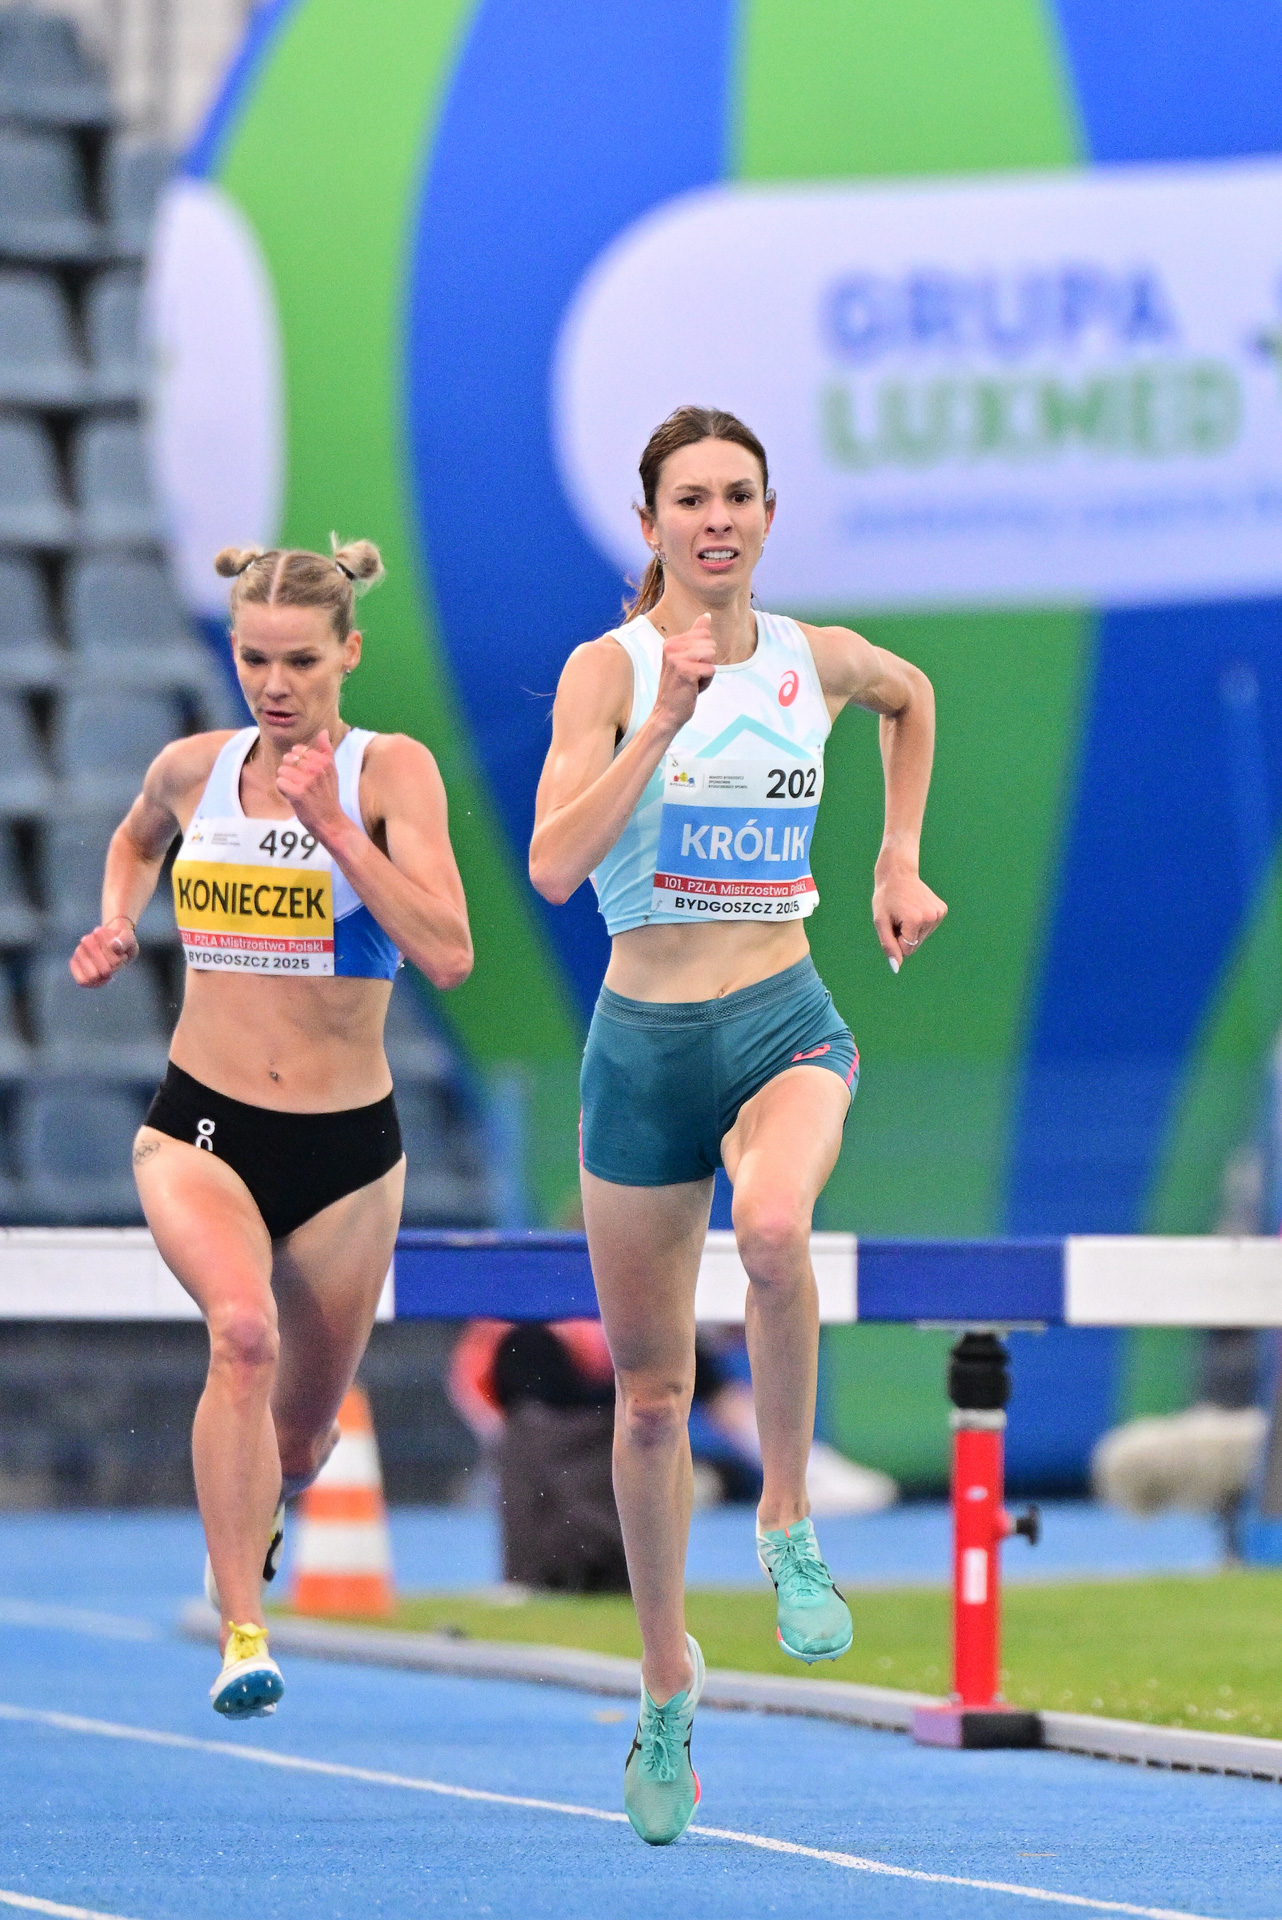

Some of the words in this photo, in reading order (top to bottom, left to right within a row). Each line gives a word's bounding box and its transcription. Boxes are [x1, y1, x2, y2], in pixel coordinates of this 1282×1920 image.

[766, 768, 817, 798] 202
[259, 829, 320, 860] 499
[680, 818, 809, 862] KRÓLIK
[177, 877, 326, 919] KONIECZEK
[664, 876, 684, 890] 101.
[687, 879, 717, 894] PZLA
[720, 884, 788, 897] Mistrzostwa
[675, 897, 772, 914] BYDGOSZCZ
[194, 935, 218, 947] PZLA
[221, 936, 286, 951] Mistrzostwa
[288, 940, 324, 952] Polski
[188, 951, 270, 967] BYDGOSZCZ
[273, 957, 310, 970] 2025
